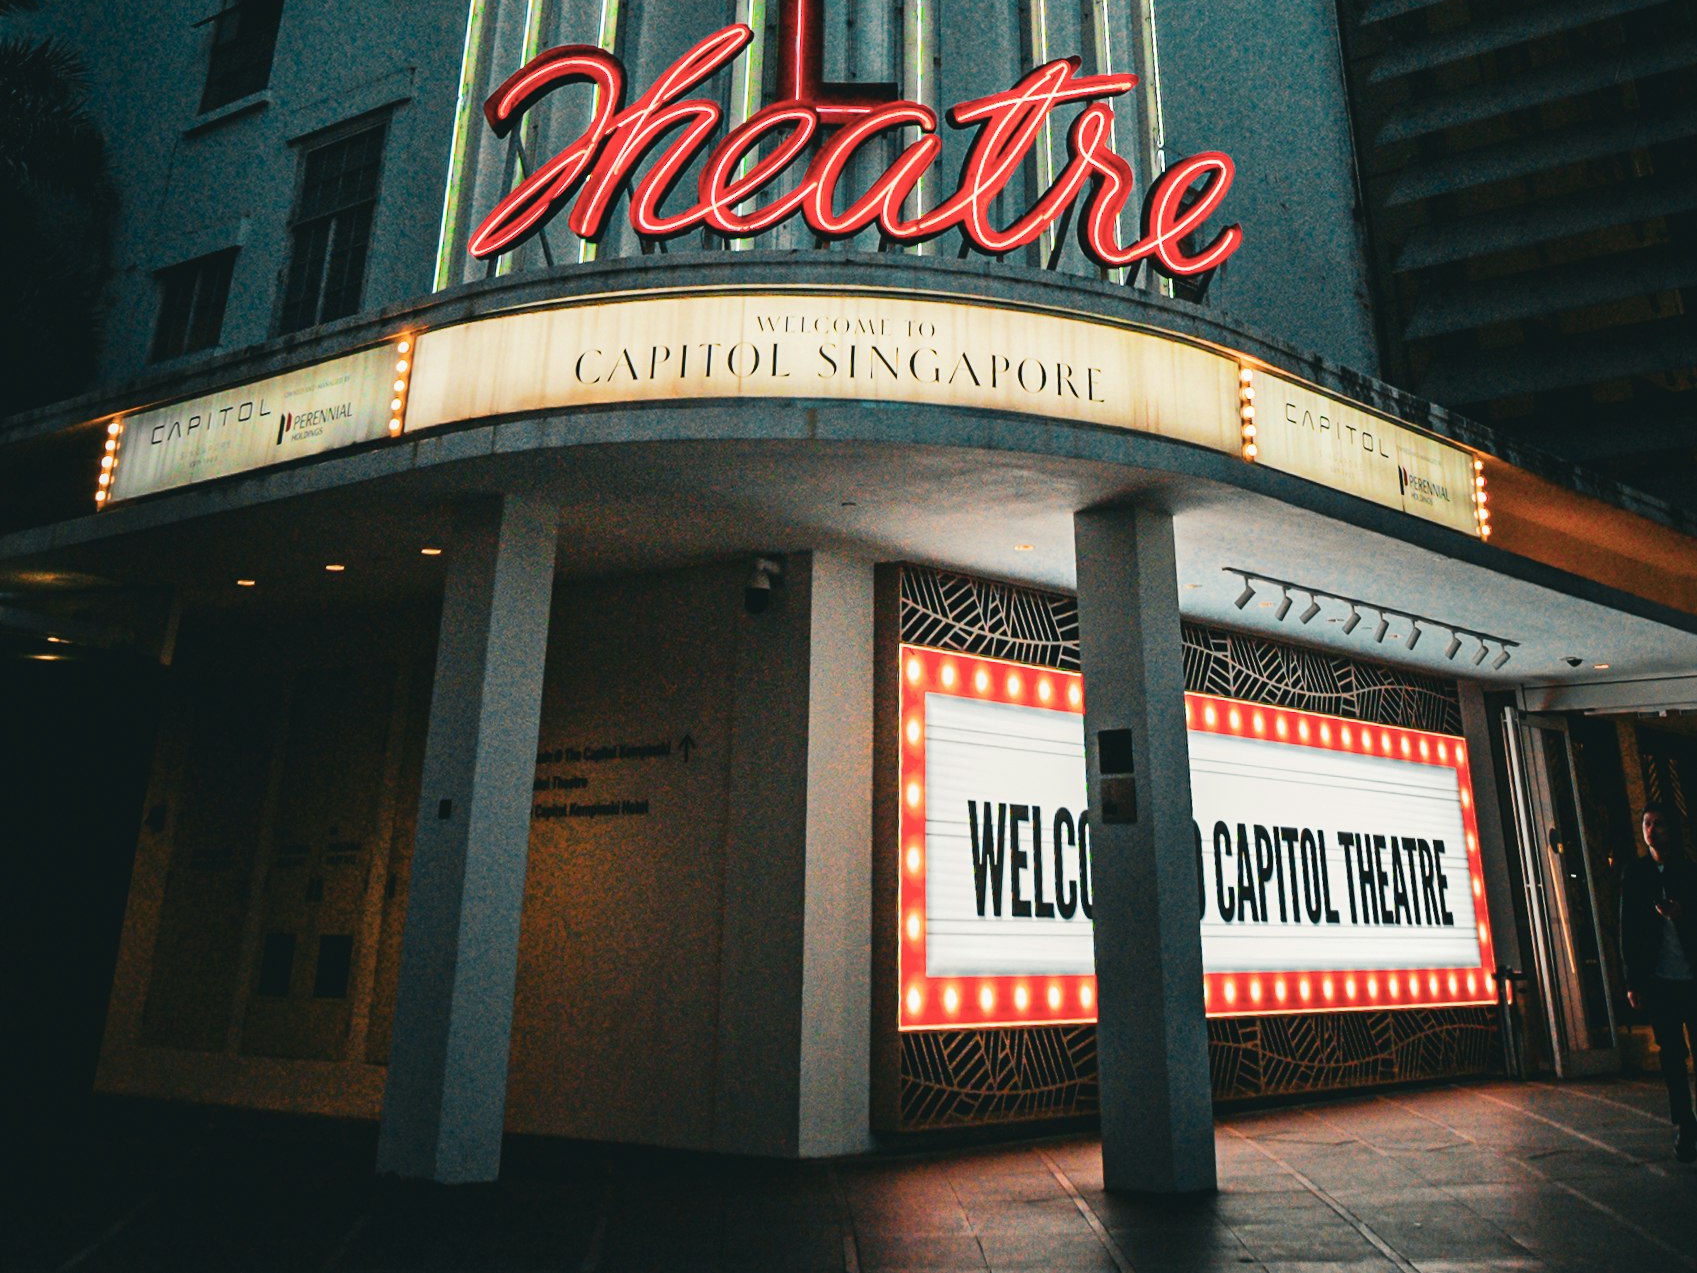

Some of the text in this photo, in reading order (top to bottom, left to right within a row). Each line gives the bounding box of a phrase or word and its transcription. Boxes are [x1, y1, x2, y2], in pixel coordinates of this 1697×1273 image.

[467, 22, 1244, 277] Theatre
[756, 314, 937, 339] WELCOME TO
[575, 341, 1106, 404] CAPITOL SINGAPORE
[150, 397, 271, 445] CAPITOL
[290, 426, 324, 442] HOLDINGS
[293, 401, 353, 431] PERENNIAL
[1285, 402, 1390, 459] CAPITOL
[1408, 473, 1451, 503] PERENNIAL
[967, 799, 1094, 920] WELCO
[1212, 820, 1341, 925] CAPITOL
[1337, 829, 1455, 927] THEATRE
